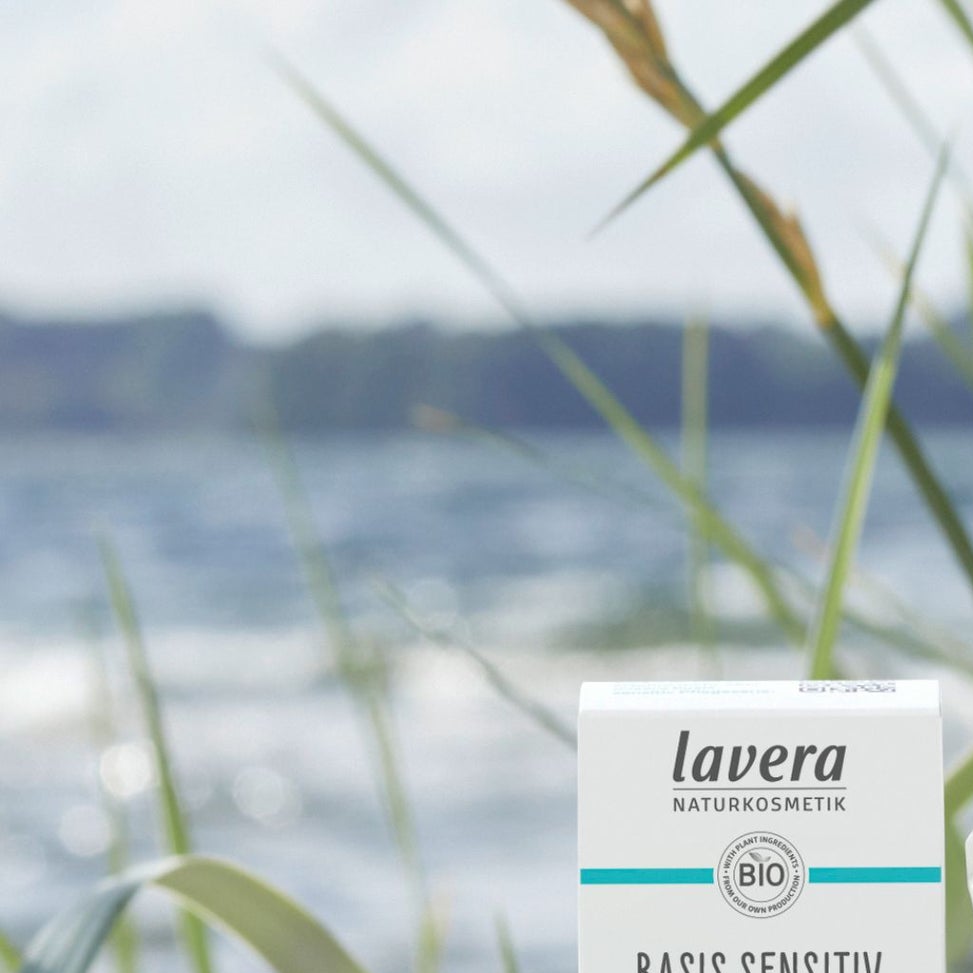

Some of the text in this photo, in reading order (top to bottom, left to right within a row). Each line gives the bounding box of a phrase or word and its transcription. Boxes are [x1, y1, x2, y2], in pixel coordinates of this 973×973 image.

[672, 730, 847, 783] lavera
[673, 796, 846, 813] NATURKOSMETIK
[723, 836, 799, 869] WITH PLANT INGREDIENTS
[738, 862, 785, 887] BIO
[723, 875, 800, 913] FROM OUR OWN PRODUCTION
